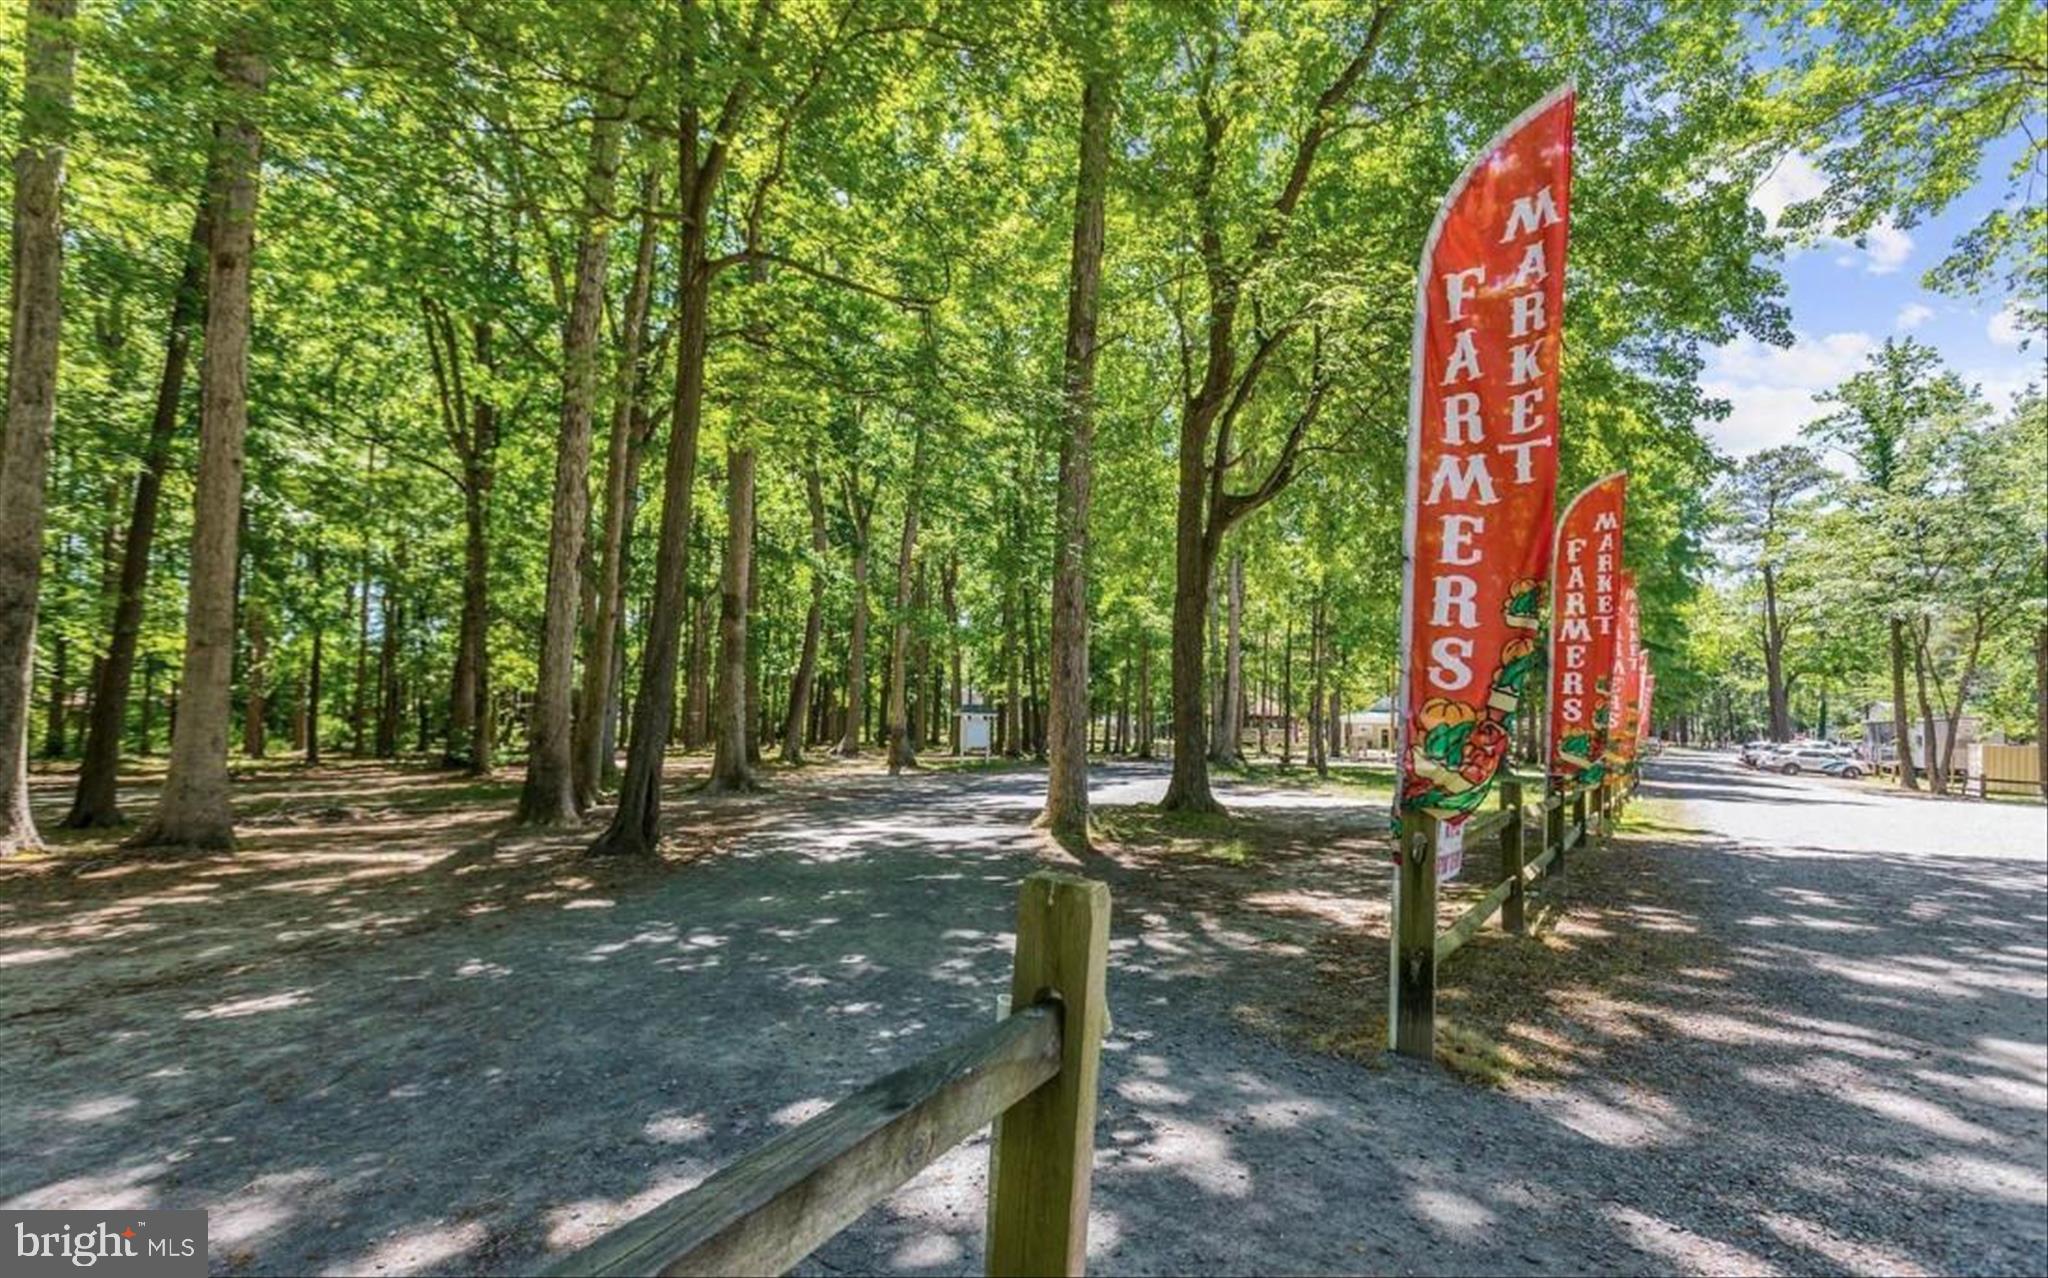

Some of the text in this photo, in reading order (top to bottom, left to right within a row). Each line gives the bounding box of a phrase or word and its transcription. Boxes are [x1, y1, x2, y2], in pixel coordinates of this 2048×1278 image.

[1498, 186, 1563, 485] MARKET
[1422, 264, 1502, 692] FARMERS
[1592, 511, 1619, 635] MARKET
[1558, 538, 1593, 723] FARMERS
